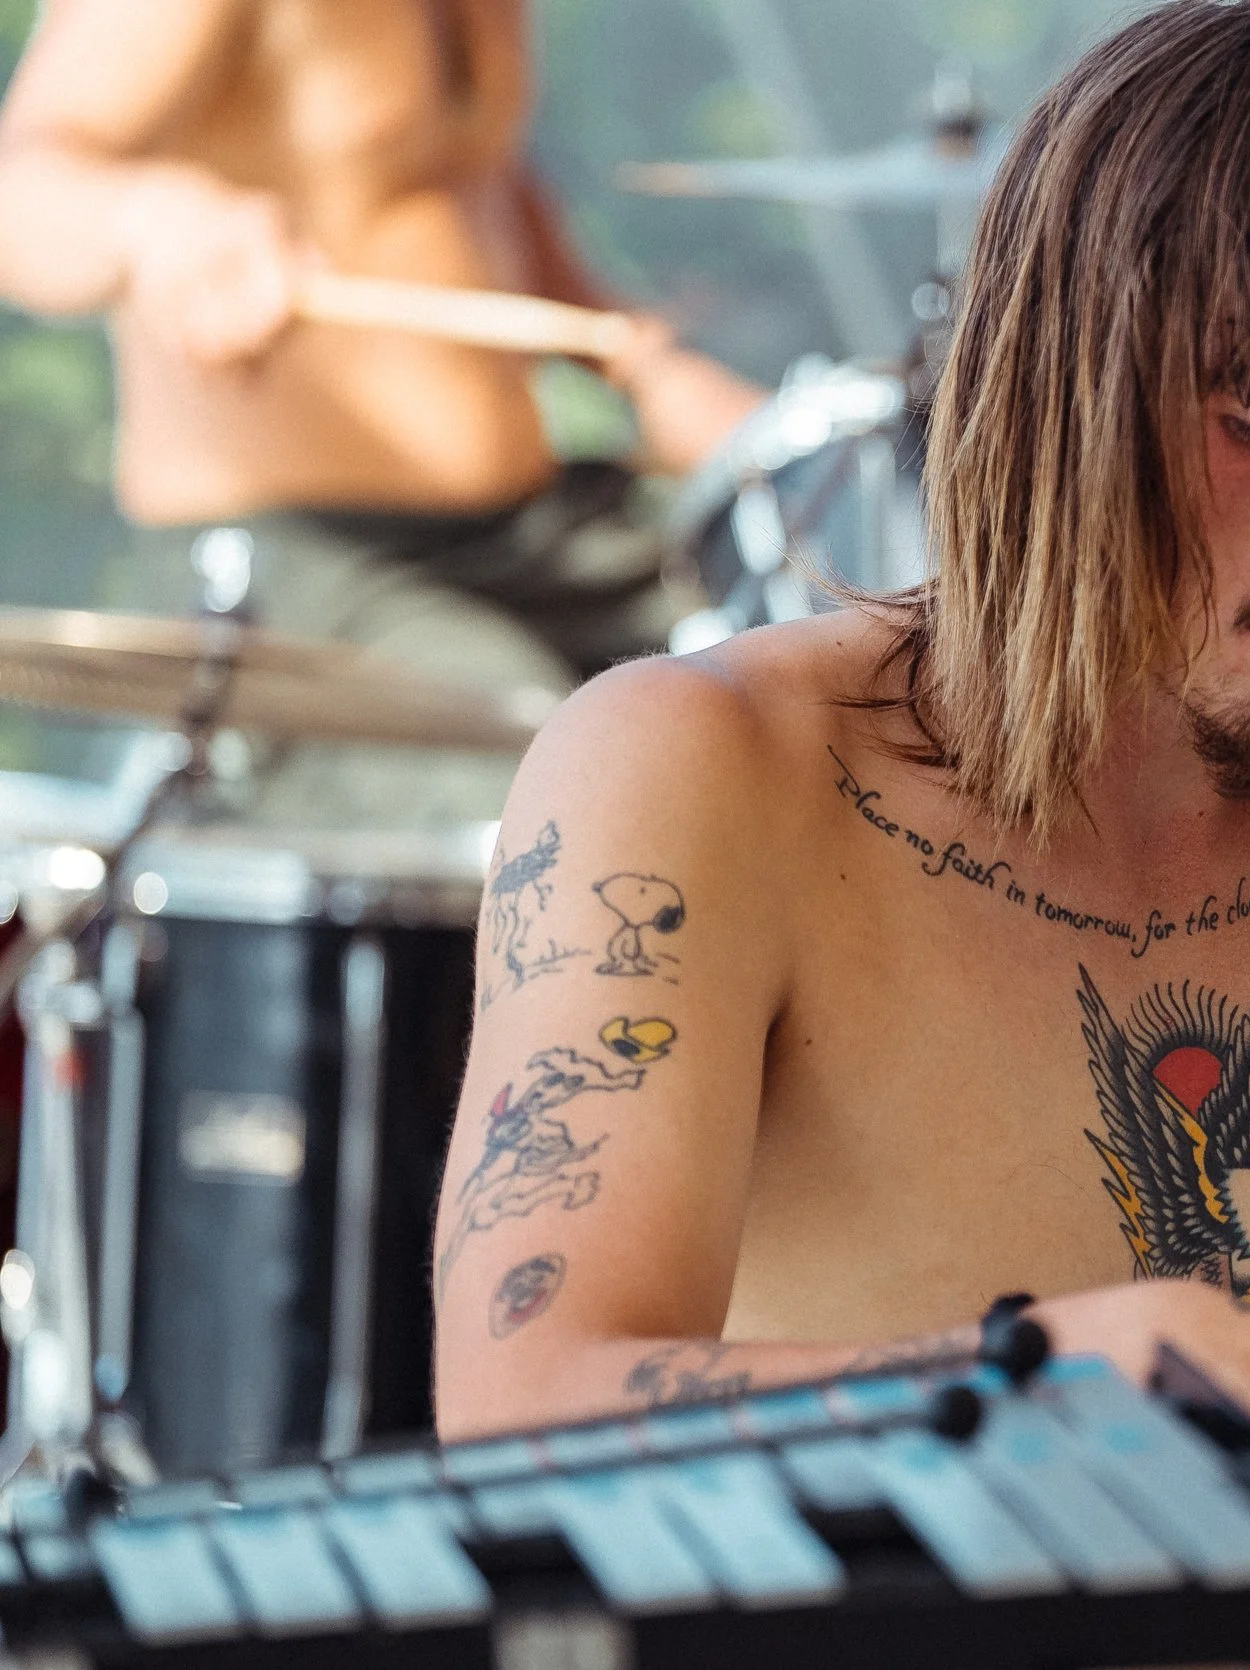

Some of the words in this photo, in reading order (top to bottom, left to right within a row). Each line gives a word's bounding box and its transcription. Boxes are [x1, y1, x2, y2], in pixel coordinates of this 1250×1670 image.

[827, 743, 900, 837] Place
[905, 829, 934, 856] no
[921, 842, 1012, 890] faith
[1005, 880, 1026, 906] in
[1035, 891, 1137, 943] tomorrow,
[1131, 909, 1177, 959] for
[1185, 894, 1220, 937] the
